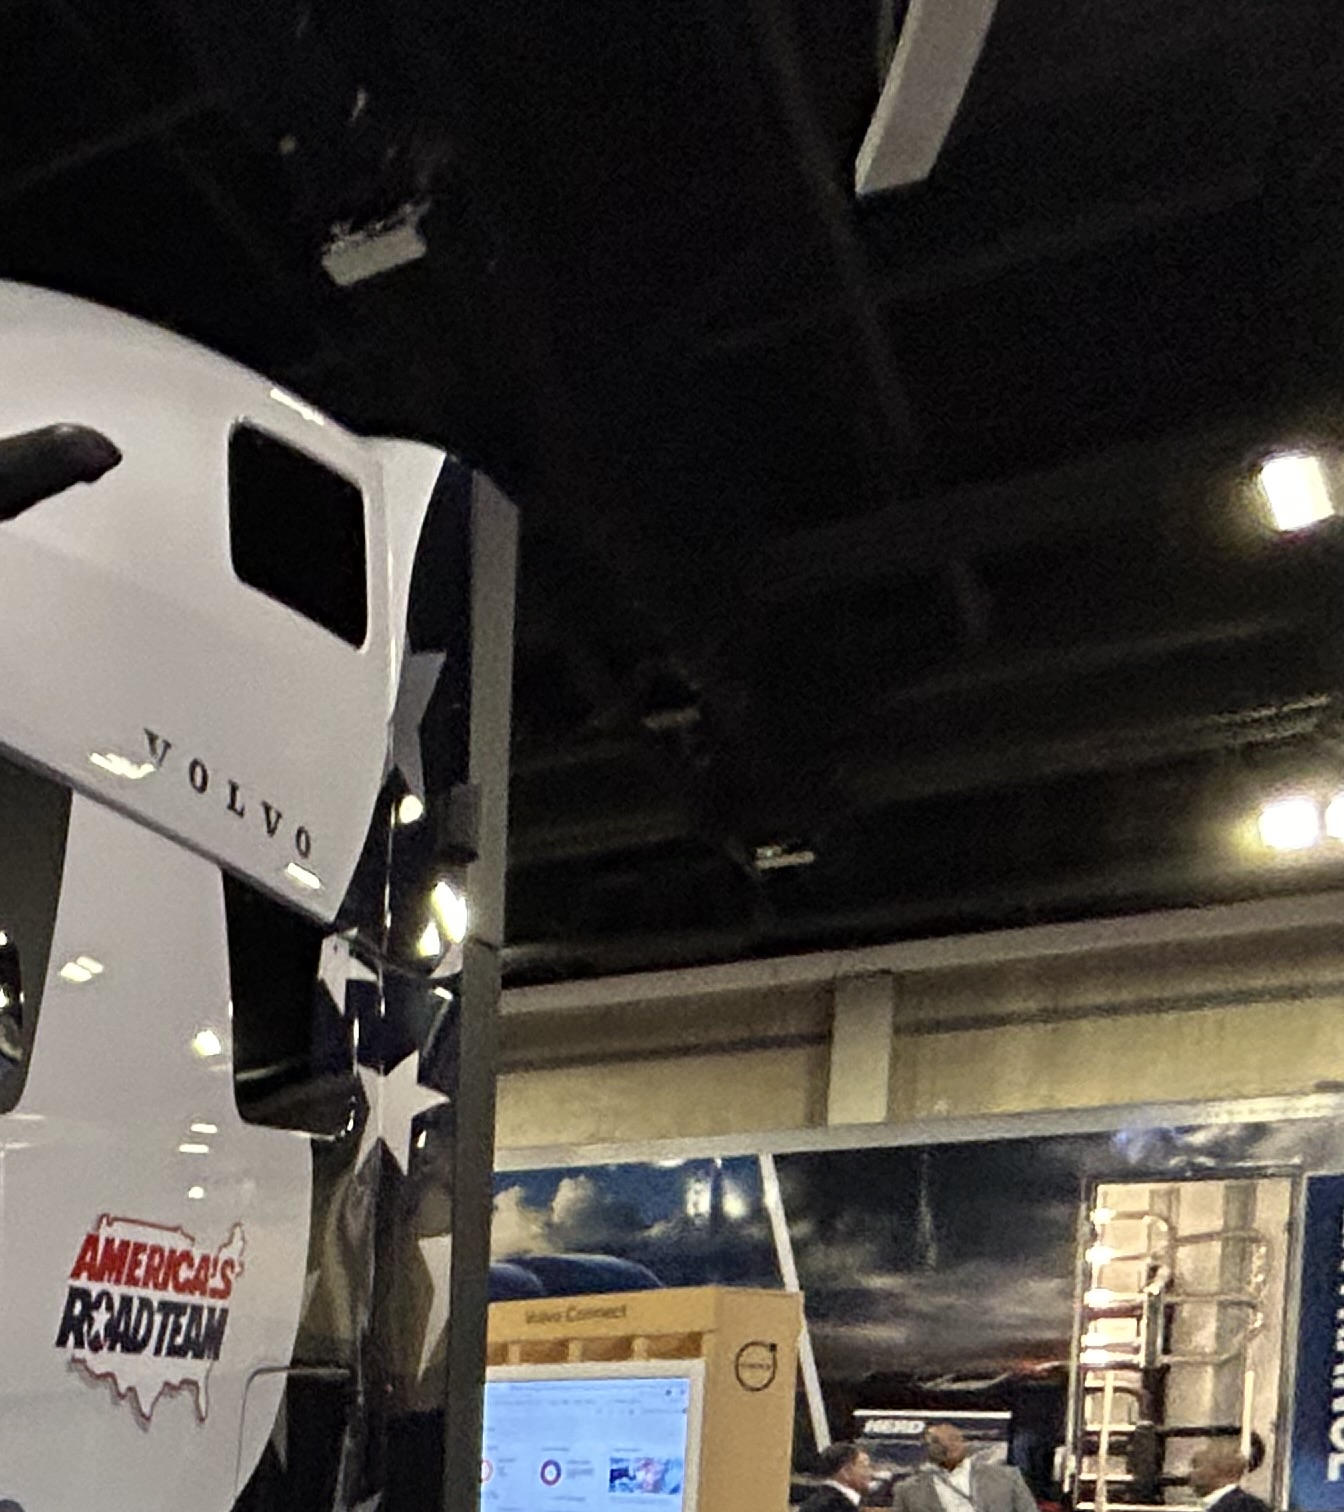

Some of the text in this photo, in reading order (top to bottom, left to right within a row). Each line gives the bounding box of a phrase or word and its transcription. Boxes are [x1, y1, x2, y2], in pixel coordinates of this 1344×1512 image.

[143, 727, 311, 859] VOLVO
[69, 1232, 235, 1300] AMERICA'S
[55, 1284, 230, 1361] ROAD TEAM
[565, 1304, 627, 1323] Connect
